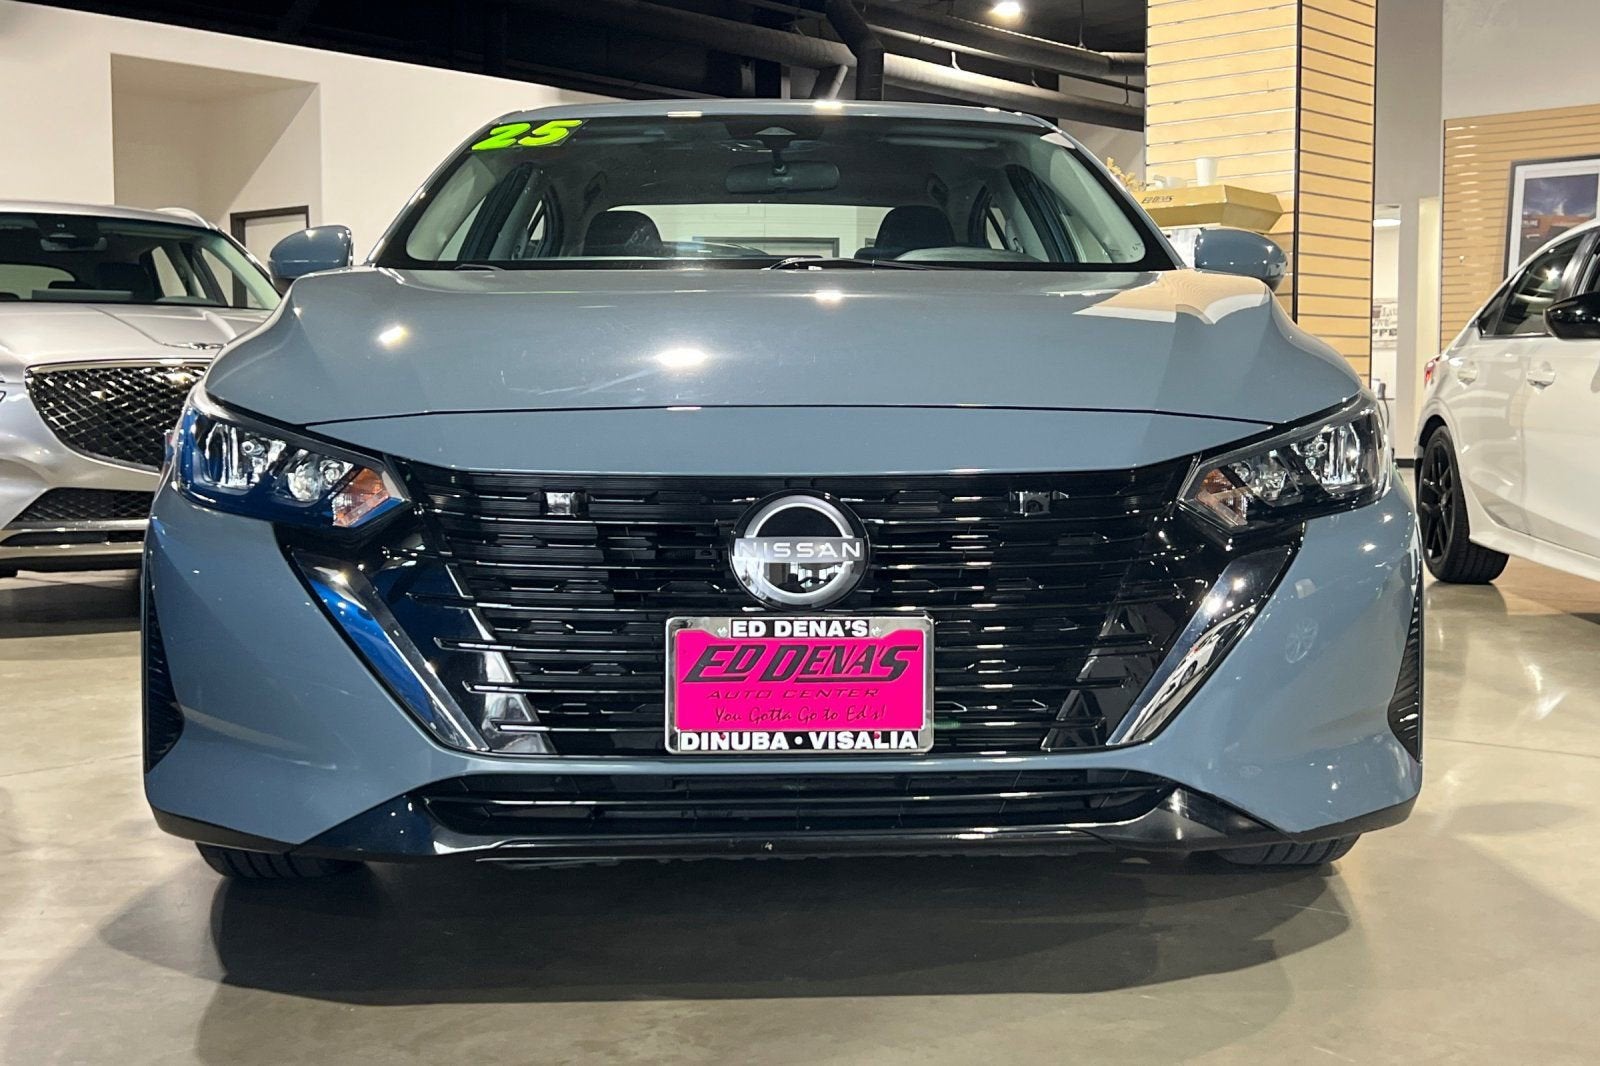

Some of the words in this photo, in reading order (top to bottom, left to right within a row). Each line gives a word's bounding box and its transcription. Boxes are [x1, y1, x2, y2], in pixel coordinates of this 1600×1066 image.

[471, 119, 583, 150] 25
[739, 541, 860, 558] NISSAN
[733, 620, 766, 637] ED
[774, 620, 868, 637] DENA'S
[682, 644, 767, 682] ED
[758, 644, 919, 682] DENA'S
[708, 689, 772, 699] AUTO
[783, 688, 879, 699] CENTER
[715, 706, 742, 723] You
[749, 706, 792, 725] Gotta
[798, 706, 817, 725] Go
[824, 708, 839, 721] to
[846, 704, 887, 721] Ed's!
[680, 731, 790, 751] DINUBA
[808, 730, 919, 750] VISALIA
